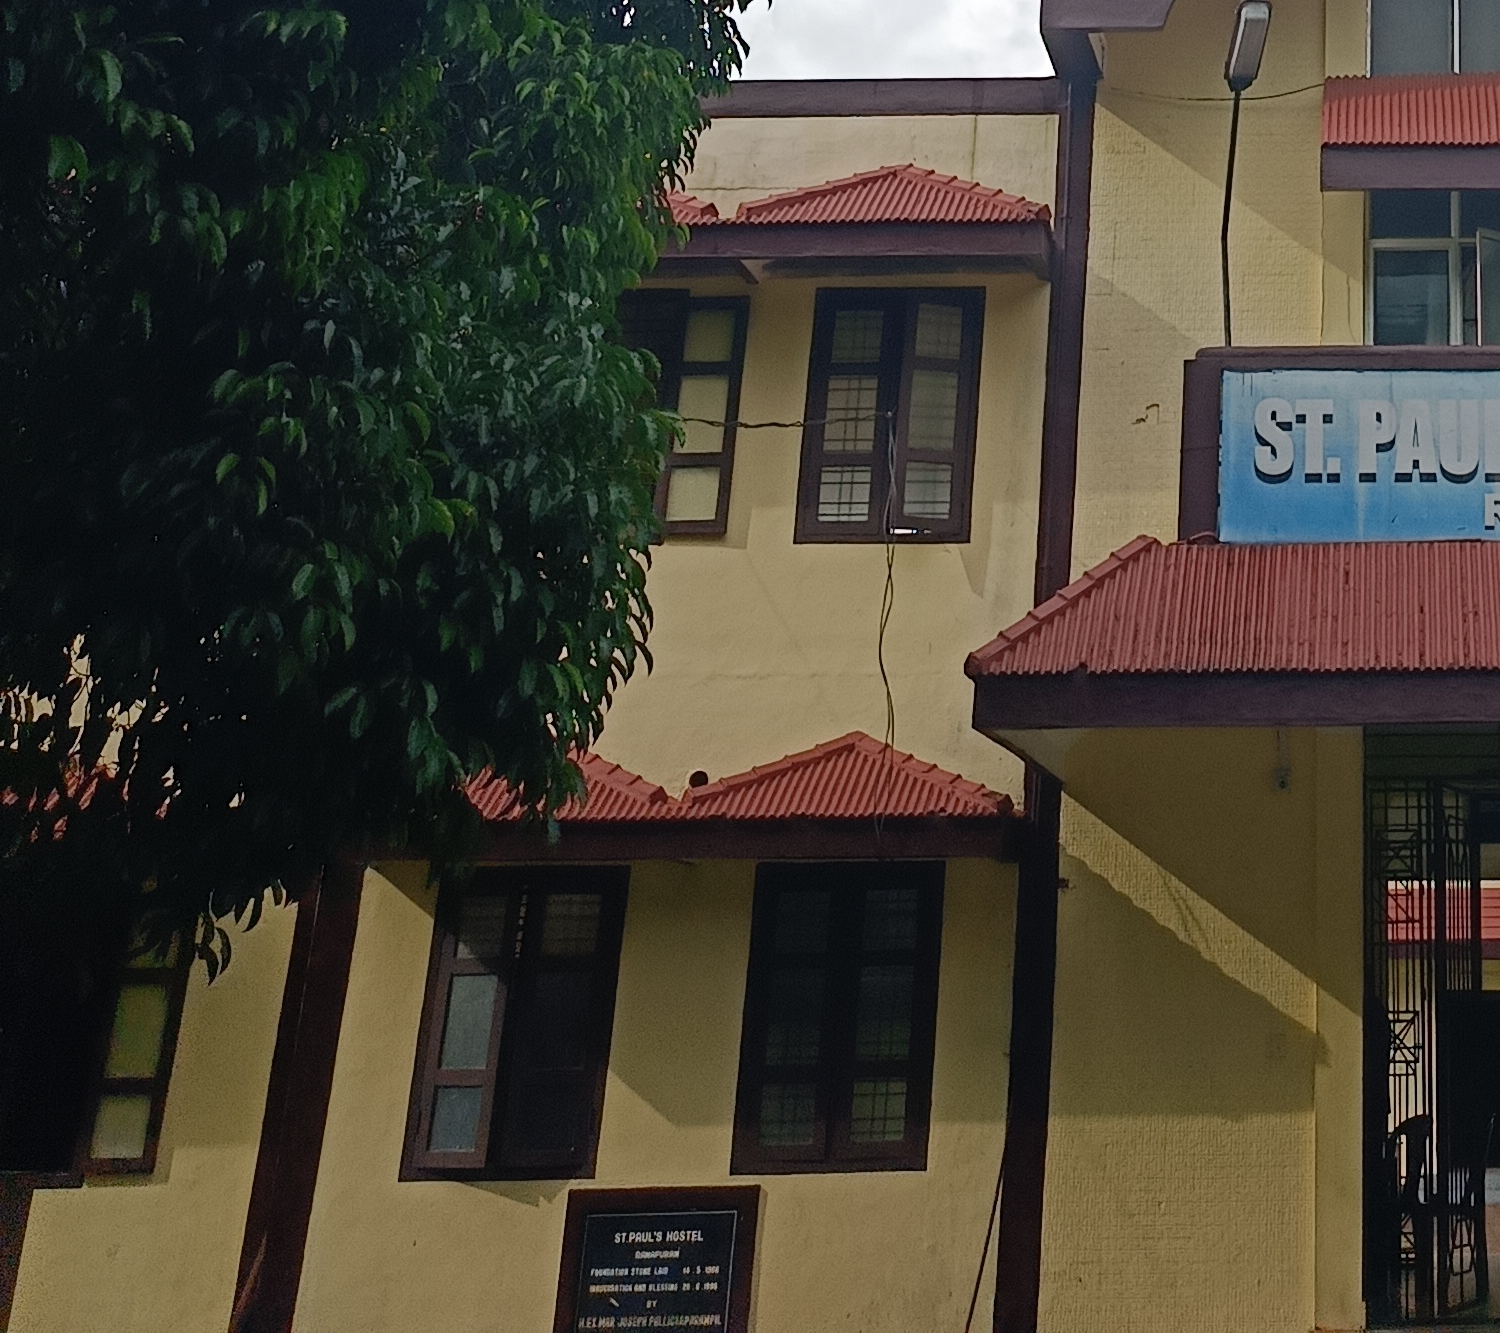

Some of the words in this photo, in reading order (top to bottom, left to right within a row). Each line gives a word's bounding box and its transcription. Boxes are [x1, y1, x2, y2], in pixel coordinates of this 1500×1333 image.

[1254, 398, 1341, 483] ST.
[666, 1230, 704, 1242] HOSTEL
[646, 1300, 658, 1309] BY
